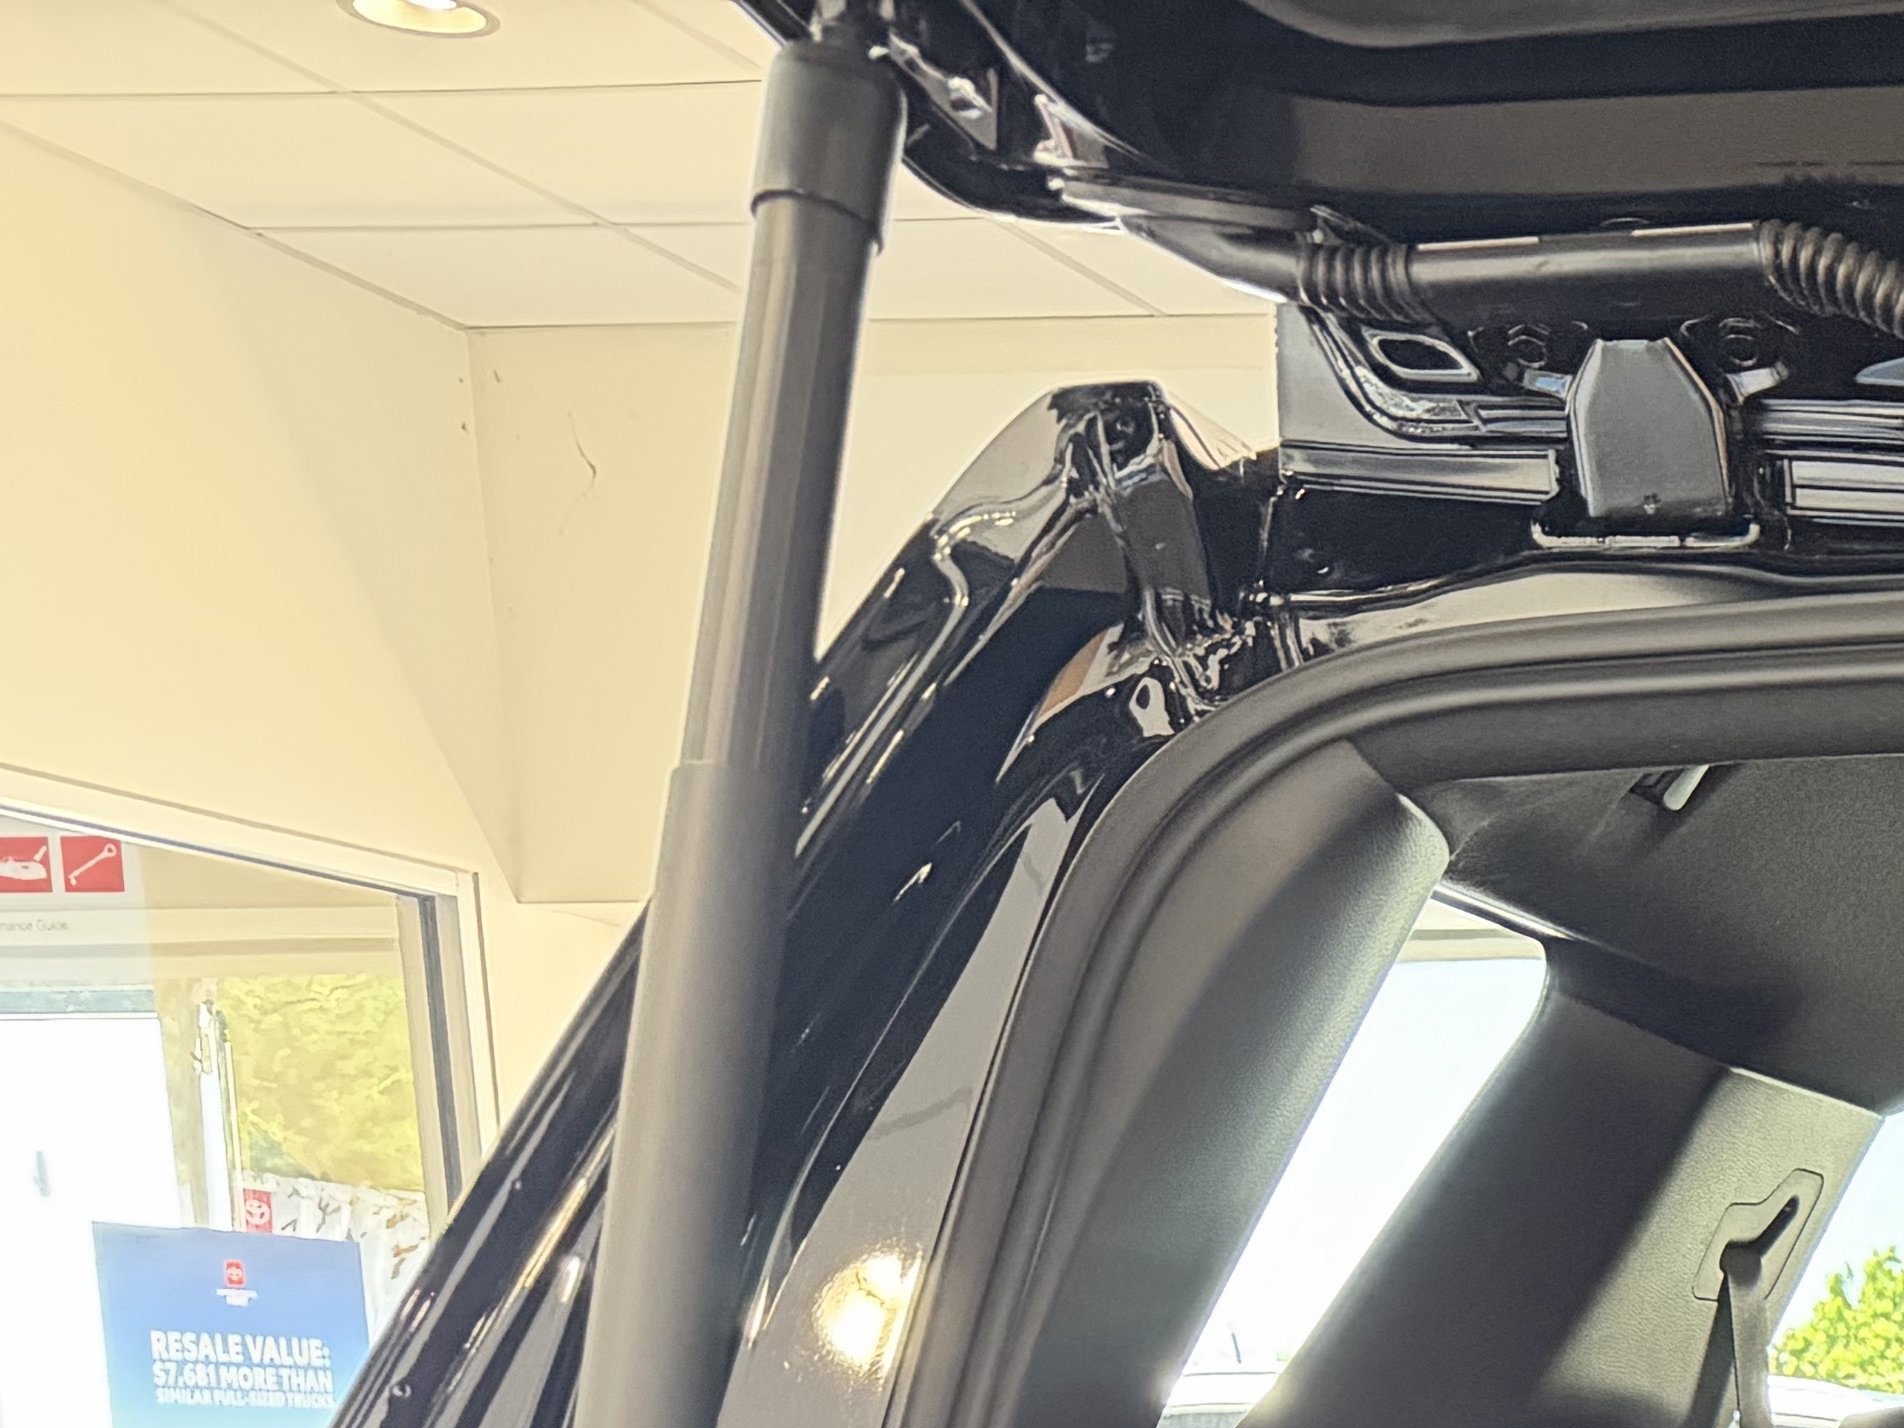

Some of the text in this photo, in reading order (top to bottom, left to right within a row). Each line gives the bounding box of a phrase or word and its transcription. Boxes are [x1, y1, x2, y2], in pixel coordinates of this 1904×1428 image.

[150, 1330, 331, 1368] RESALE VALUE:
[220, 1364, 278, 1391] MORE
[278, 1366, 334, 1393] THAN
